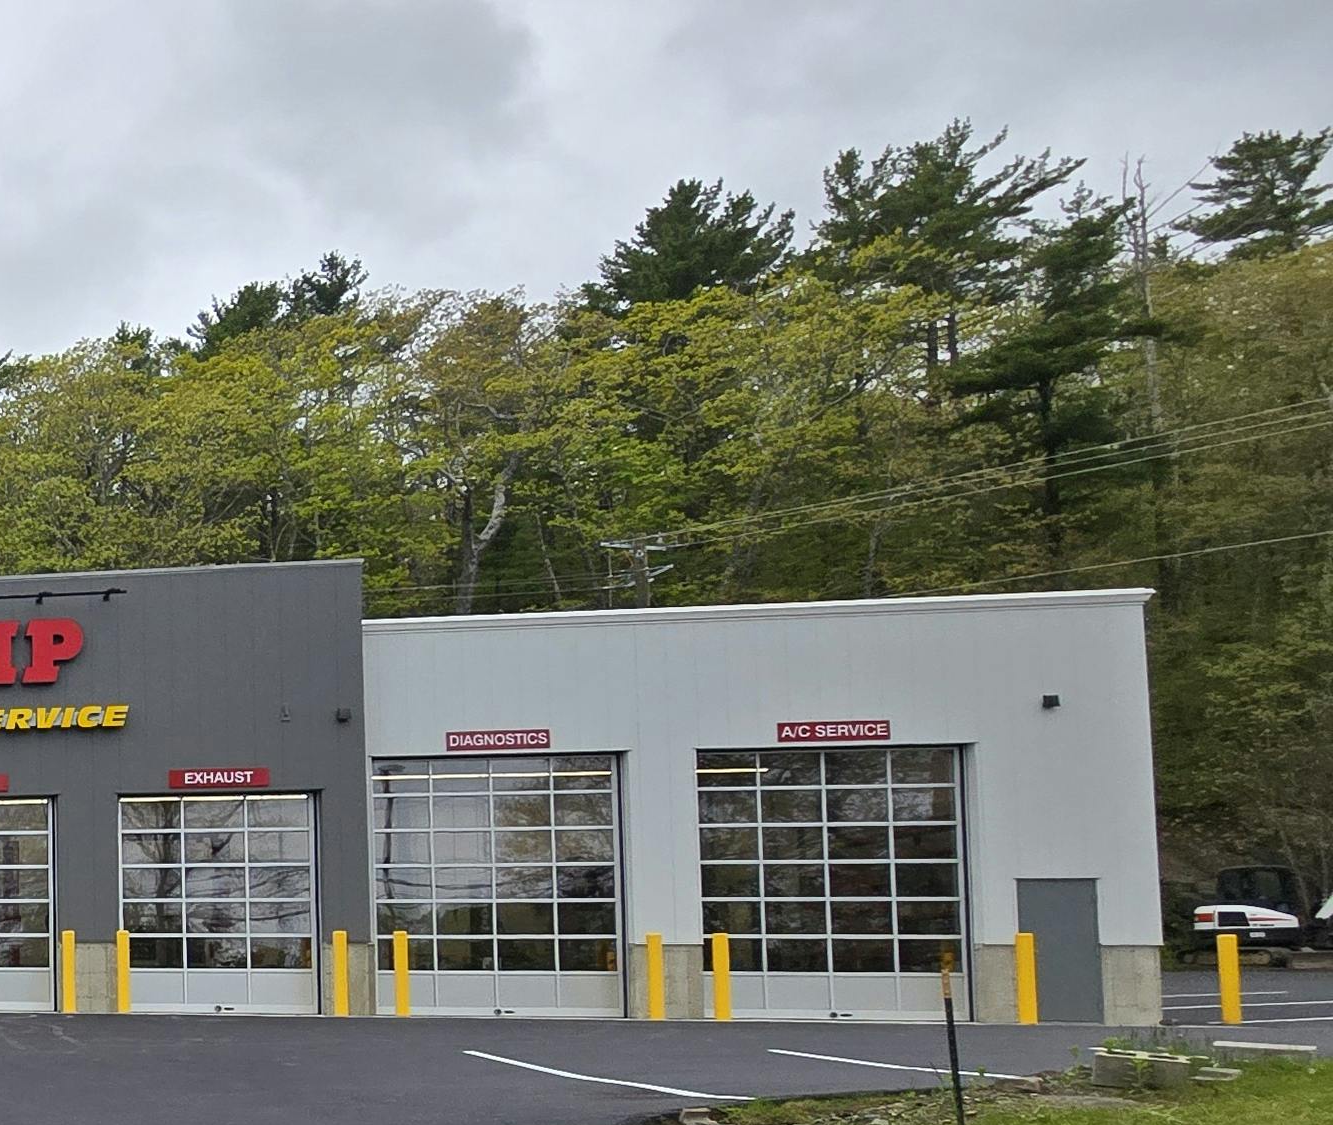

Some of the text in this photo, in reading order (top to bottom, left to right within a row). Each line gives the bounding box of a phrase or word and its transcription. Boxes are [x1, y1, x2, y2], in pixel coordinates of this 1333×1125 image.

[780, 723, 889, 738] A/C SERVICE
[448, 732, 548, 748] DIAGNOSTICS
[183, 771, 254, 785] EXHAUST
